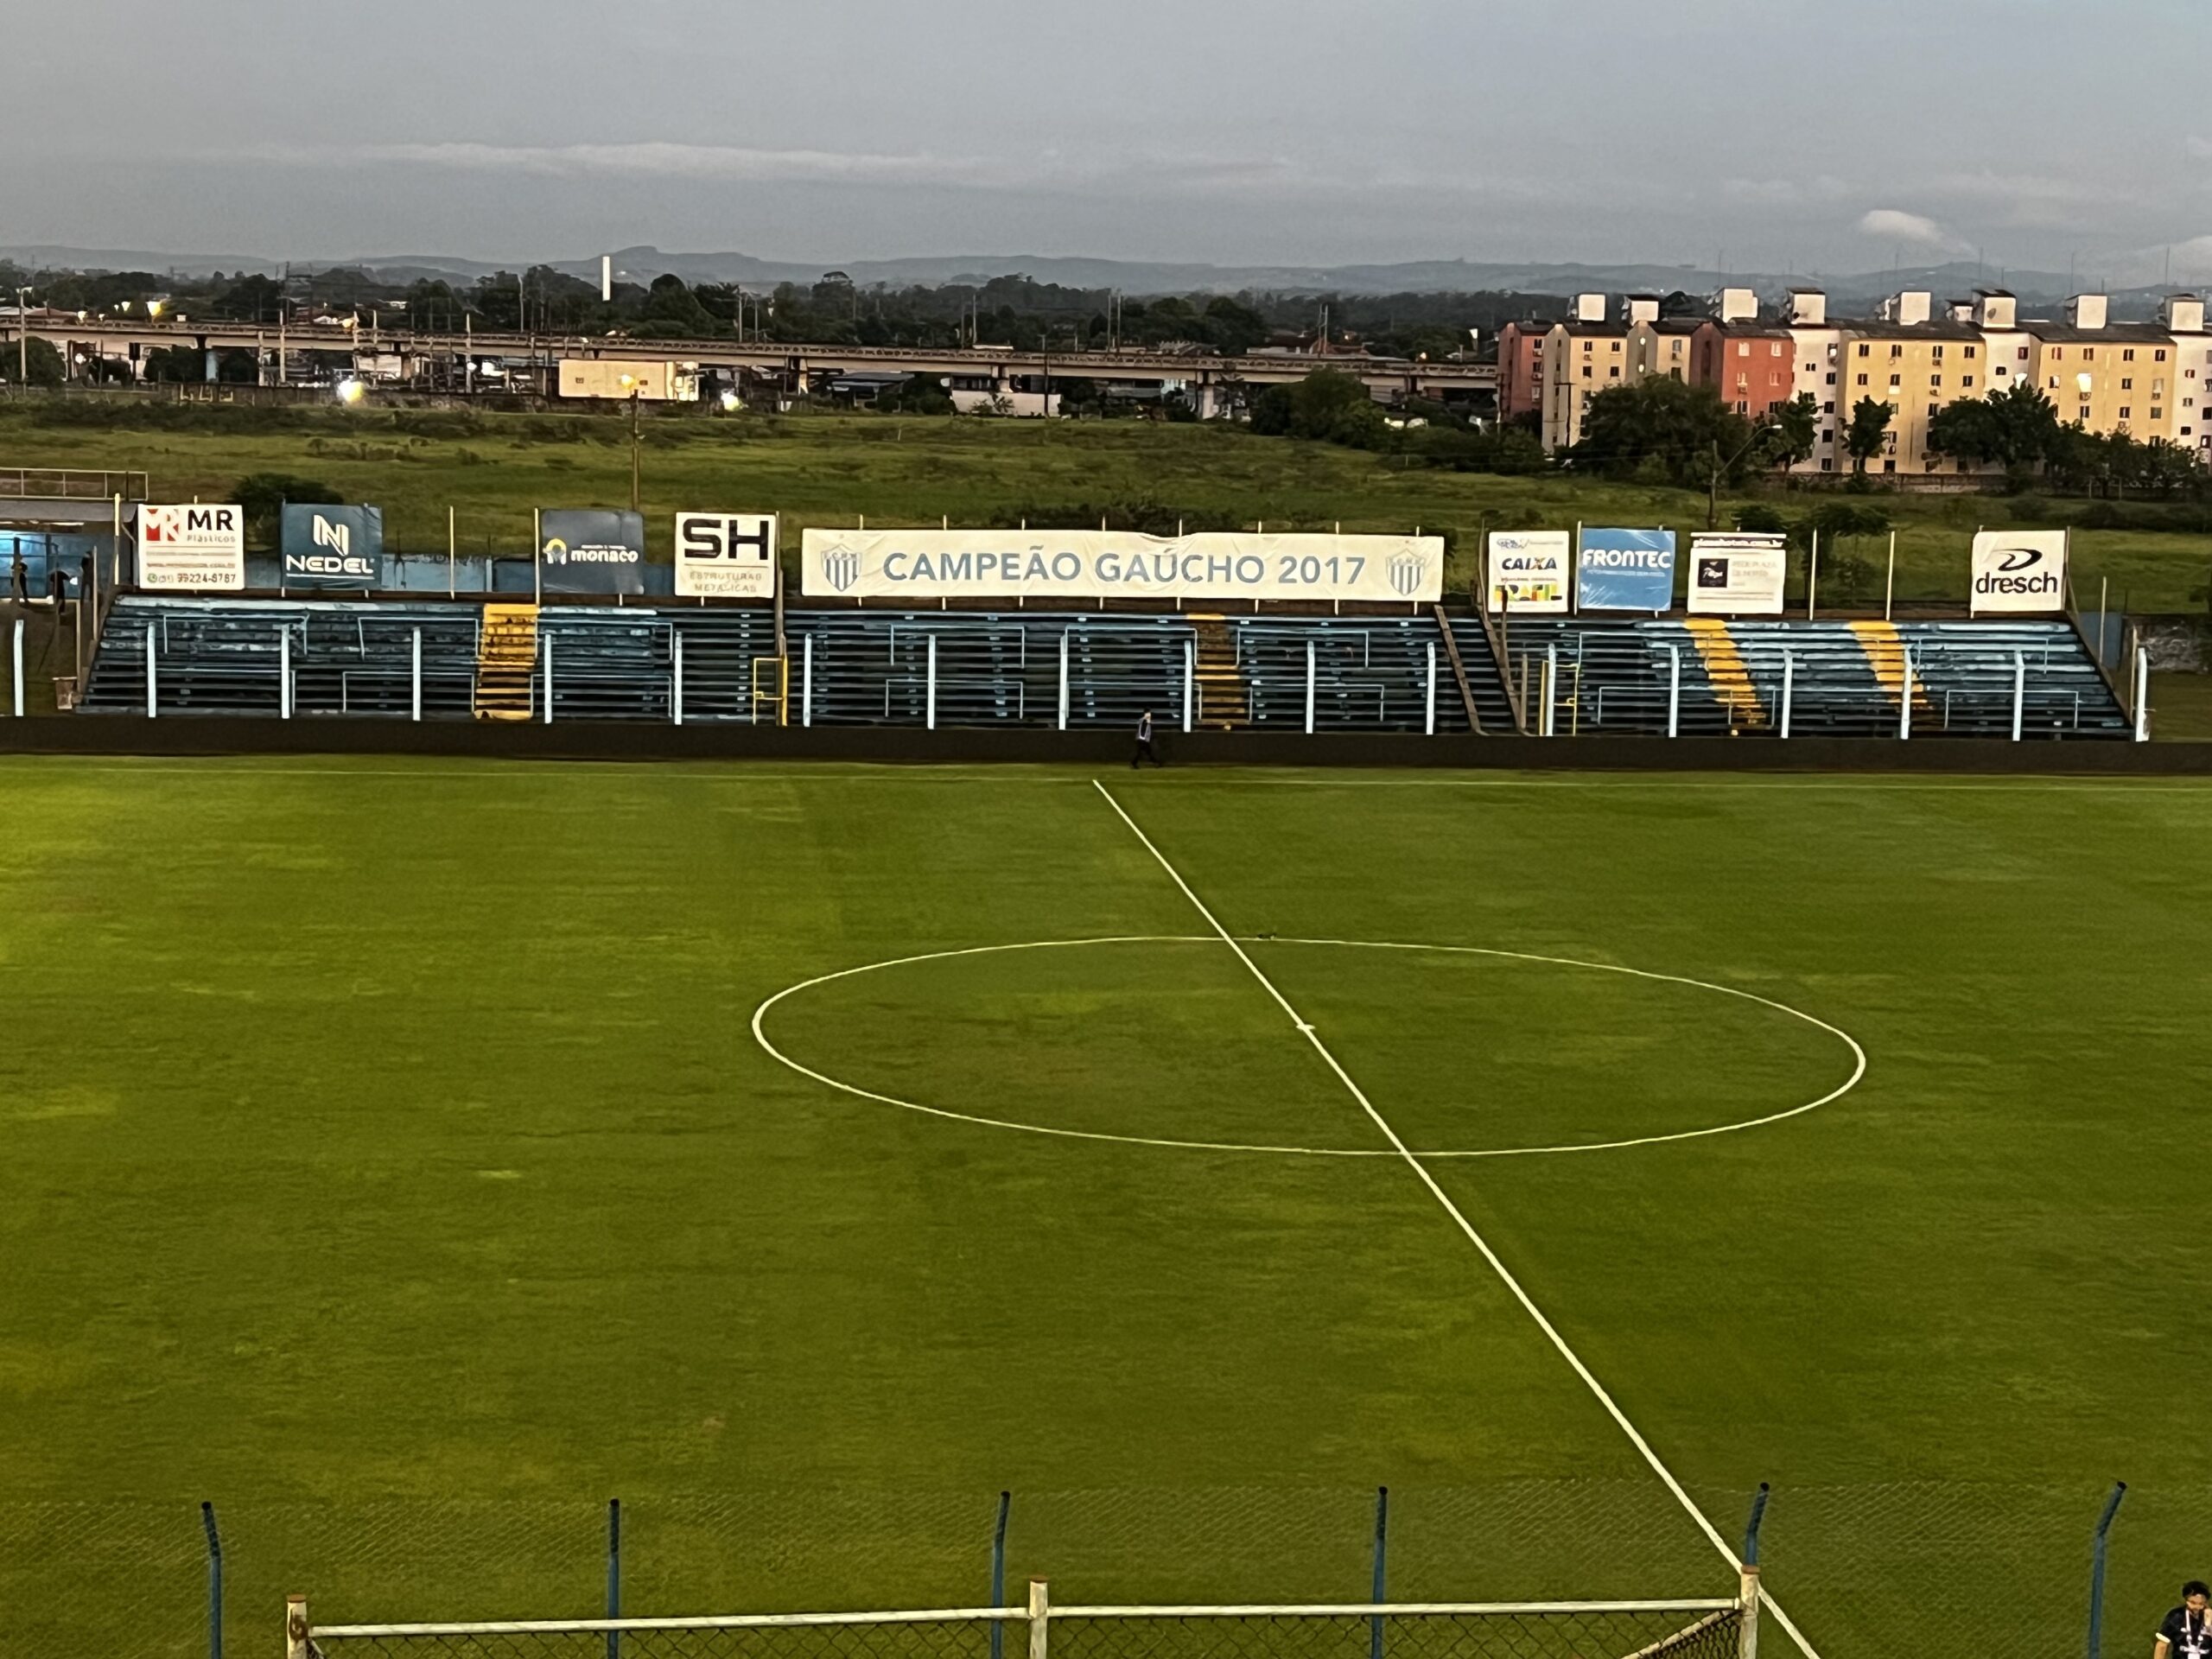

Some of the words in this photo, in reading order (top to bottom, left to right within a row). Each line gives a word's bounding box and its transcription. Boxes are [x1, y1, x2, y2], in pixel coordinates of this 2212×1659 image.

[188, 509, 234, 531] MR
[683, 518, 769, 560] SH
[286, 554, 373, 574] NEDEL
[570, 550, 639, 563] monaco
[883, 545, 1082, 582] CAMPEÃO
[1095, 548, 1264, 583] GAÚCHO
[1278, 556, 1365, 584] 2017
[1502, 557, 1557, 570] CAIXA
[1582, 549, 1671, 568] FRONTEC
[1975, 571, 2058, 594] dresch
